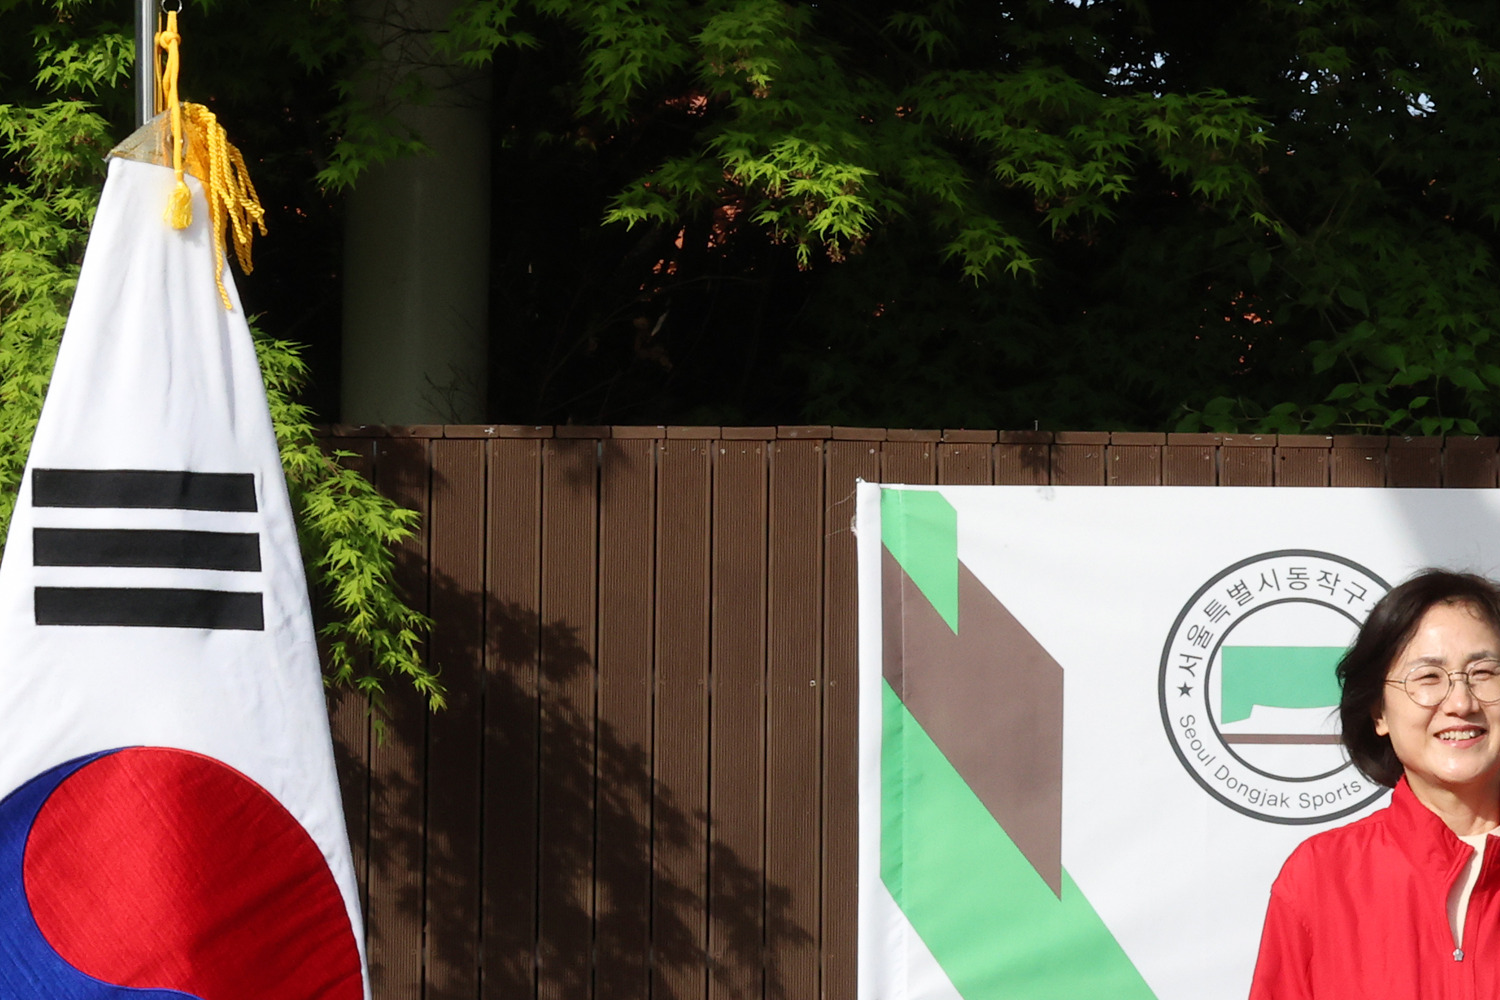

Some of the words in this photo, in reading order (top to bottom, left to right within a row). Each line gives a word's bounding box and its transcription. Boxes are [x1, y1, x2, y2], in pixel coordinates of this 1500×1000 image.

[1178, 567, 1375, 677] 서울특별시동작구
[1179, 713, 1216, 766] Seoul
[1215, 765, 1291, 808] Dongjak
[1299, 780, 1362, 809] Sports
